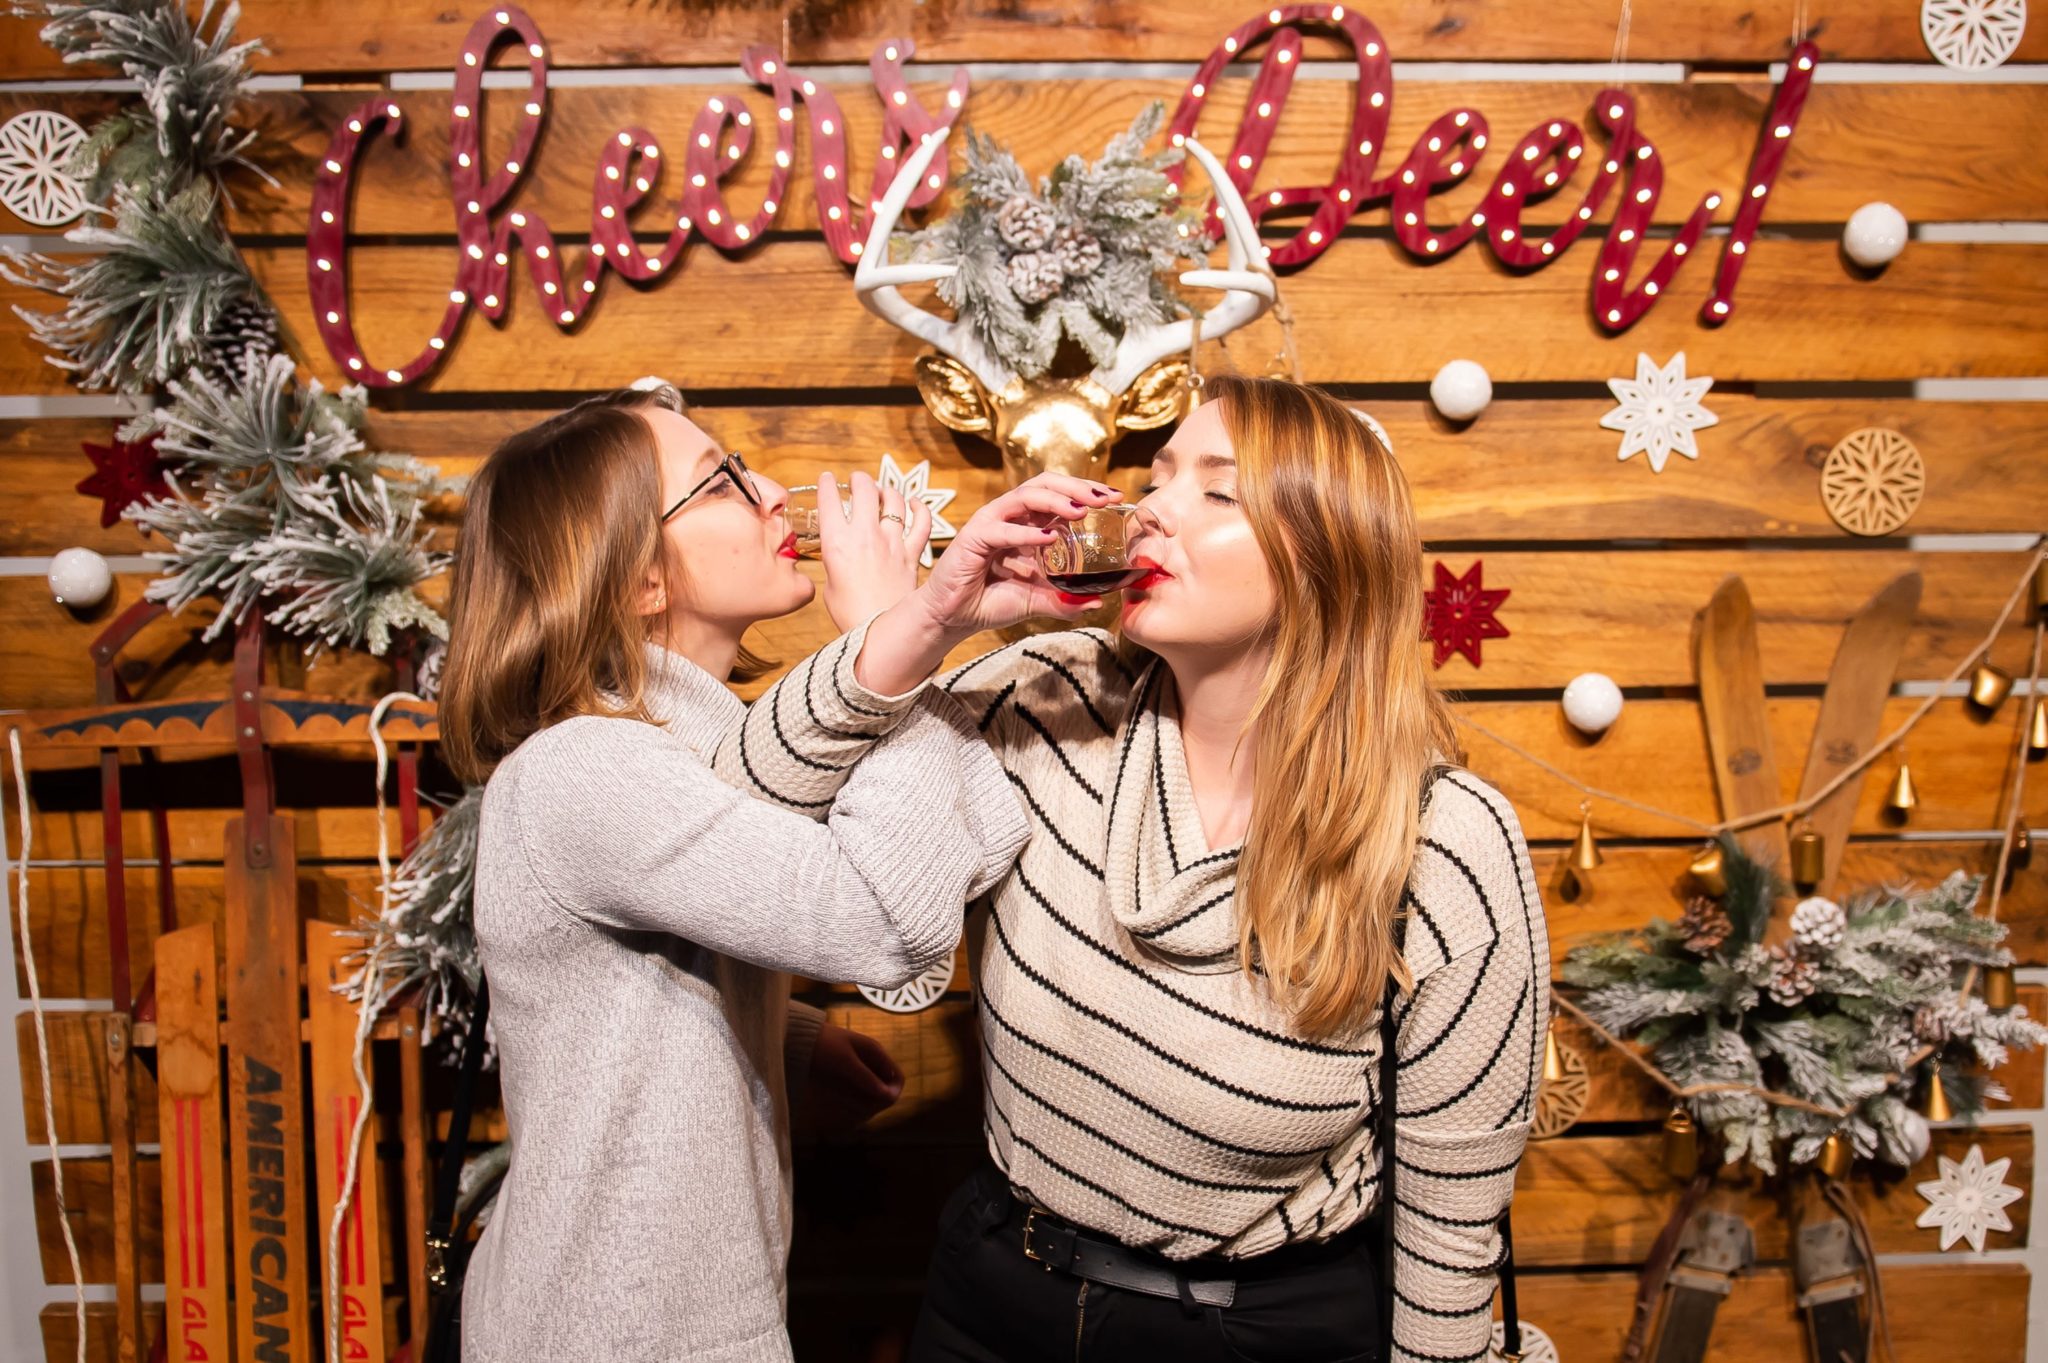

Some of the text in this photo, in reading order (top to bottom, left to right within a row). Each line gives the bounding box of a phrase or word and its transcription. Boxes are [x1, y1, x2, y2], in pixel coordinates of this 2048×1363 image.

[307, 2, 1820, 388] Cheers Deer!
[244, 1055, 290, 1363] AMERICAN
